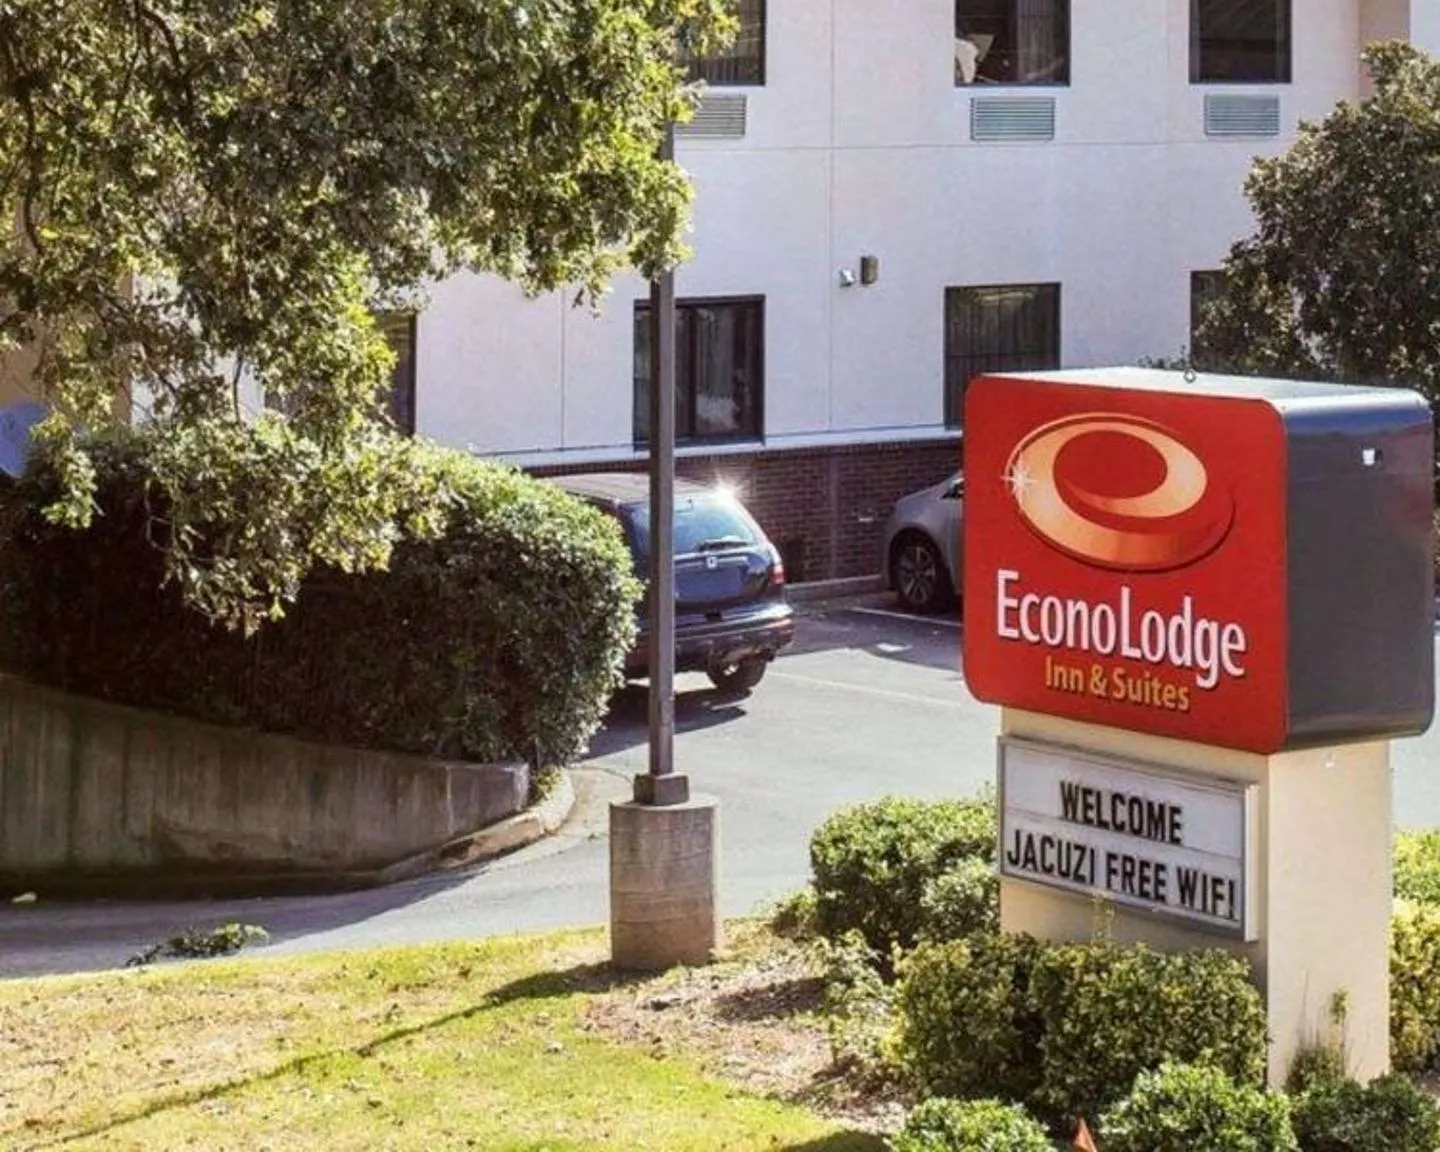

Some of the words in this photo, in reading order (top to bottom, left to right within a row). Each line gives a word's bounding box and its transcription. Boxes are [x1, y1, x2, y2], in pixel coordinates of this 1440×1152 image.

[996, 569, 1246, 689] EconoLodge
[1045, 656, 1085, 693] Inn
[1090, 666, 1111, 696] &
[1113, 669, 1190, 712] Suites
[1060, 780, 1182, 845] WELCOME
[1007, 829, 1096, 885] JACUZI
[1106, 851, 1167, 903] FREE
[1177, 865, 1235, 920] WIFI
